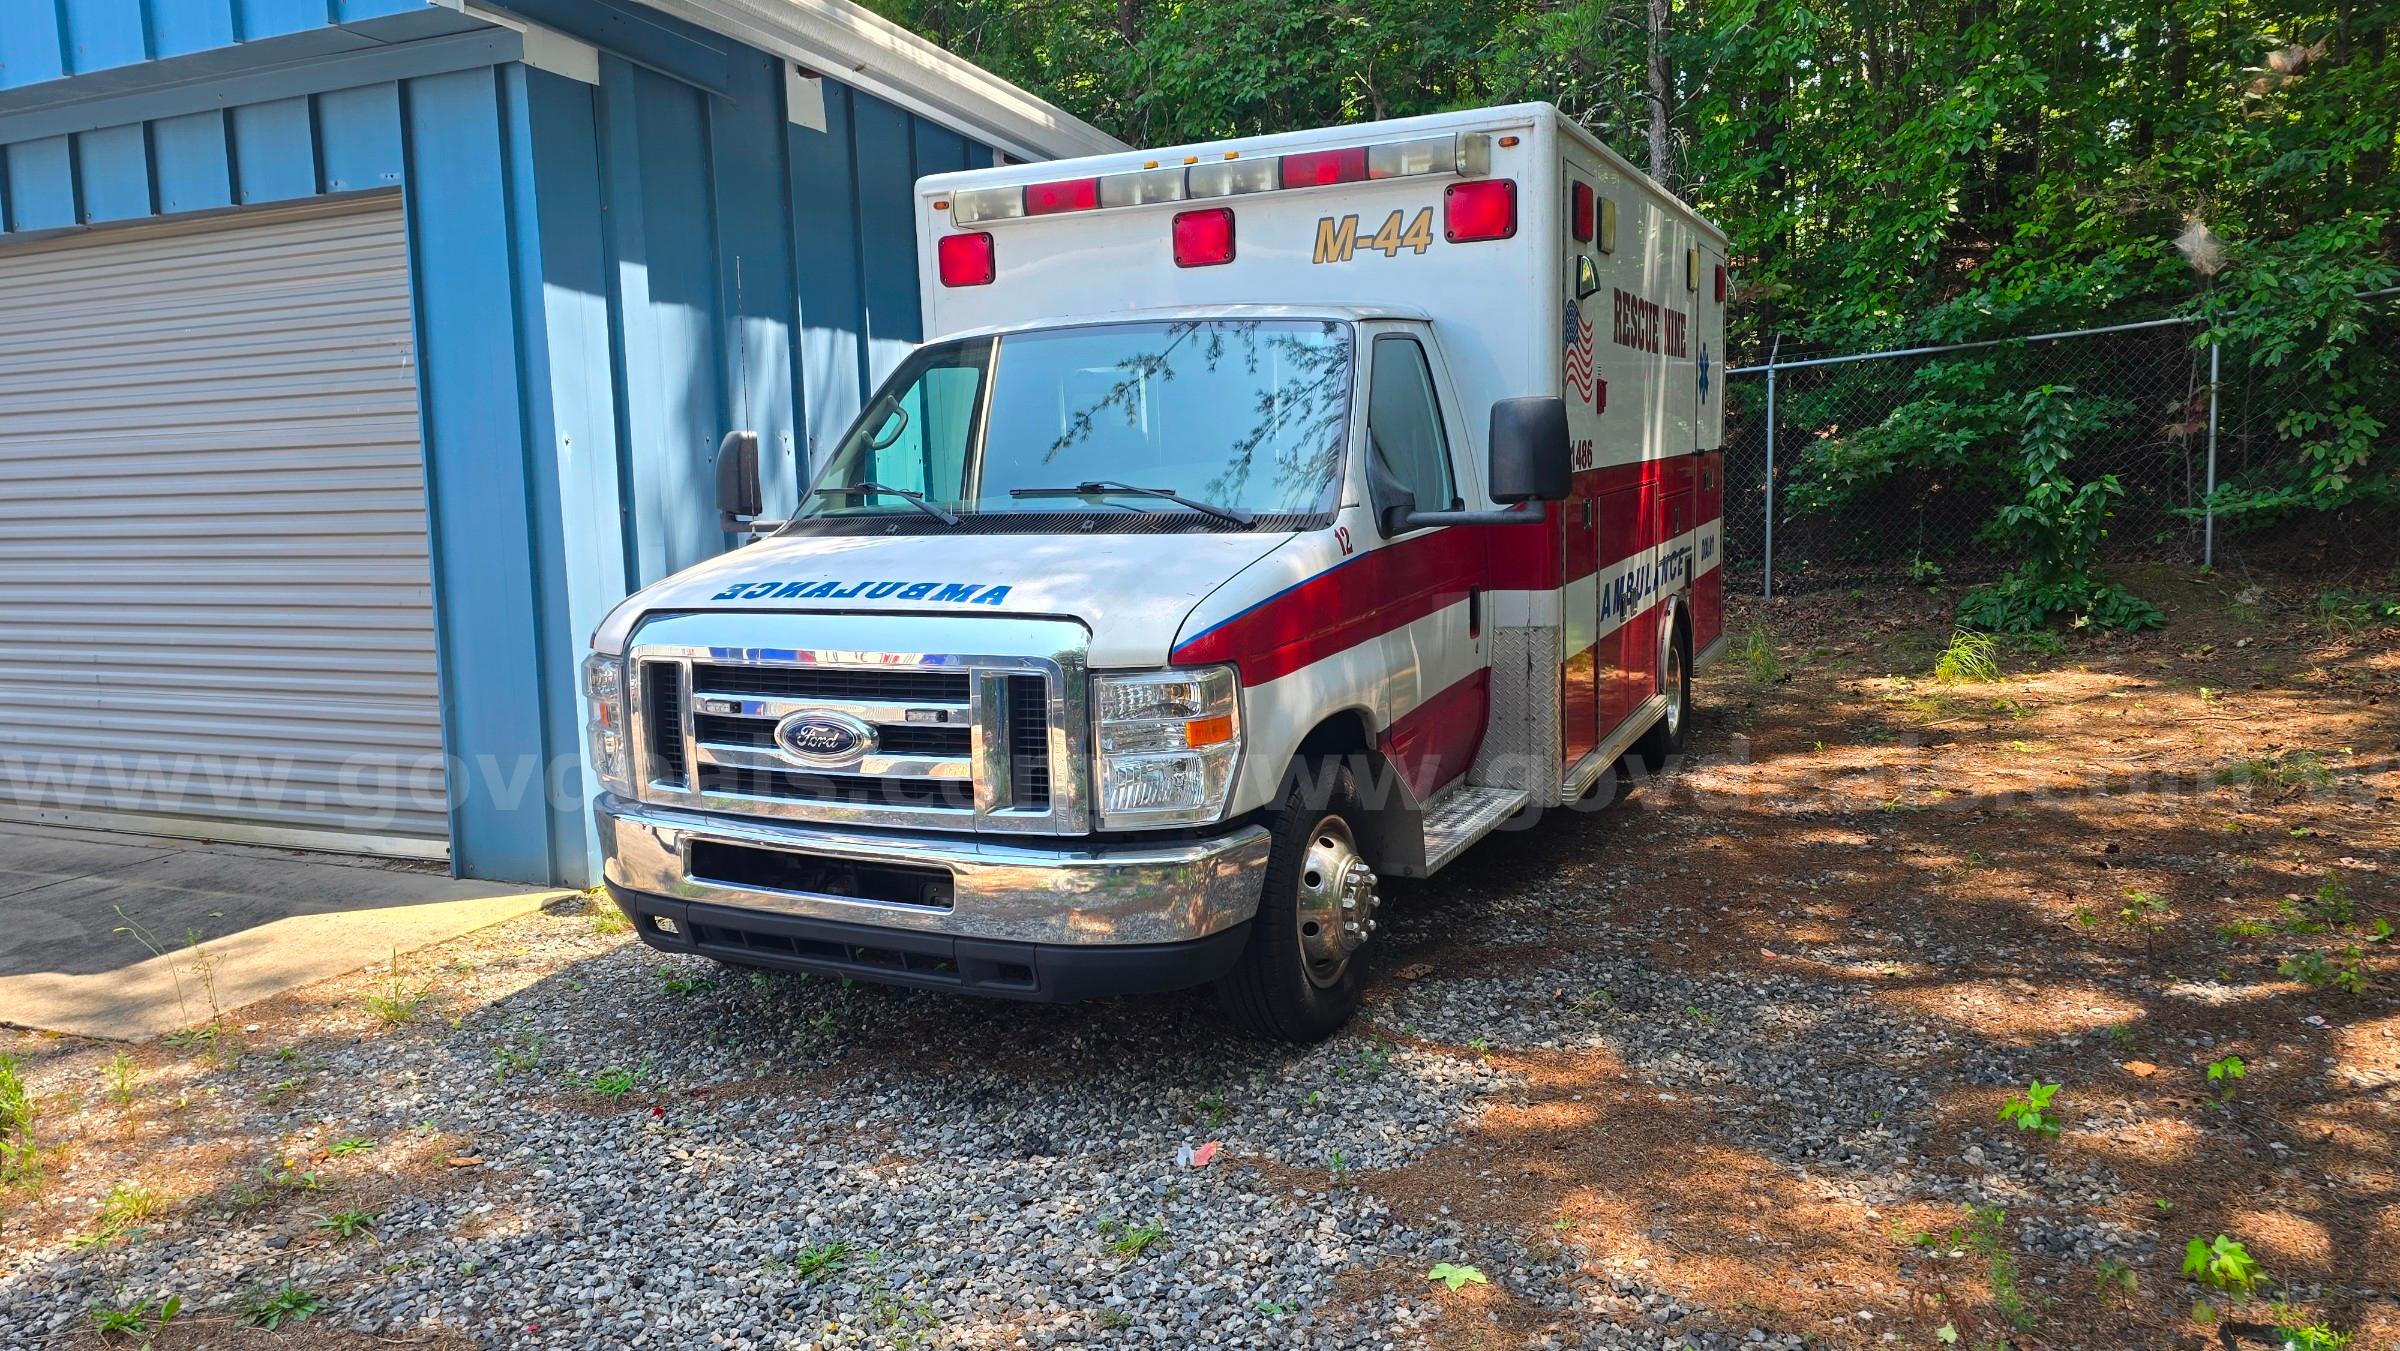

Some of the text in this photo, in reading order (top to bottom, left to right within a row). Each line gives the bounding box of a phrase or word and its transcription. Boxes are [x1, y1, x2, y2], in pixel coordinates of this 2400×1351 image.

[1311, 205, 1435, 265] M-44
[1613, 287, 1687, 359] RESCUE NINE
[1334, 526, 1354, 557] 12
[1600, 555, 1684, 623] AMBULANCE
[796, 725, 841, 749] Ford
